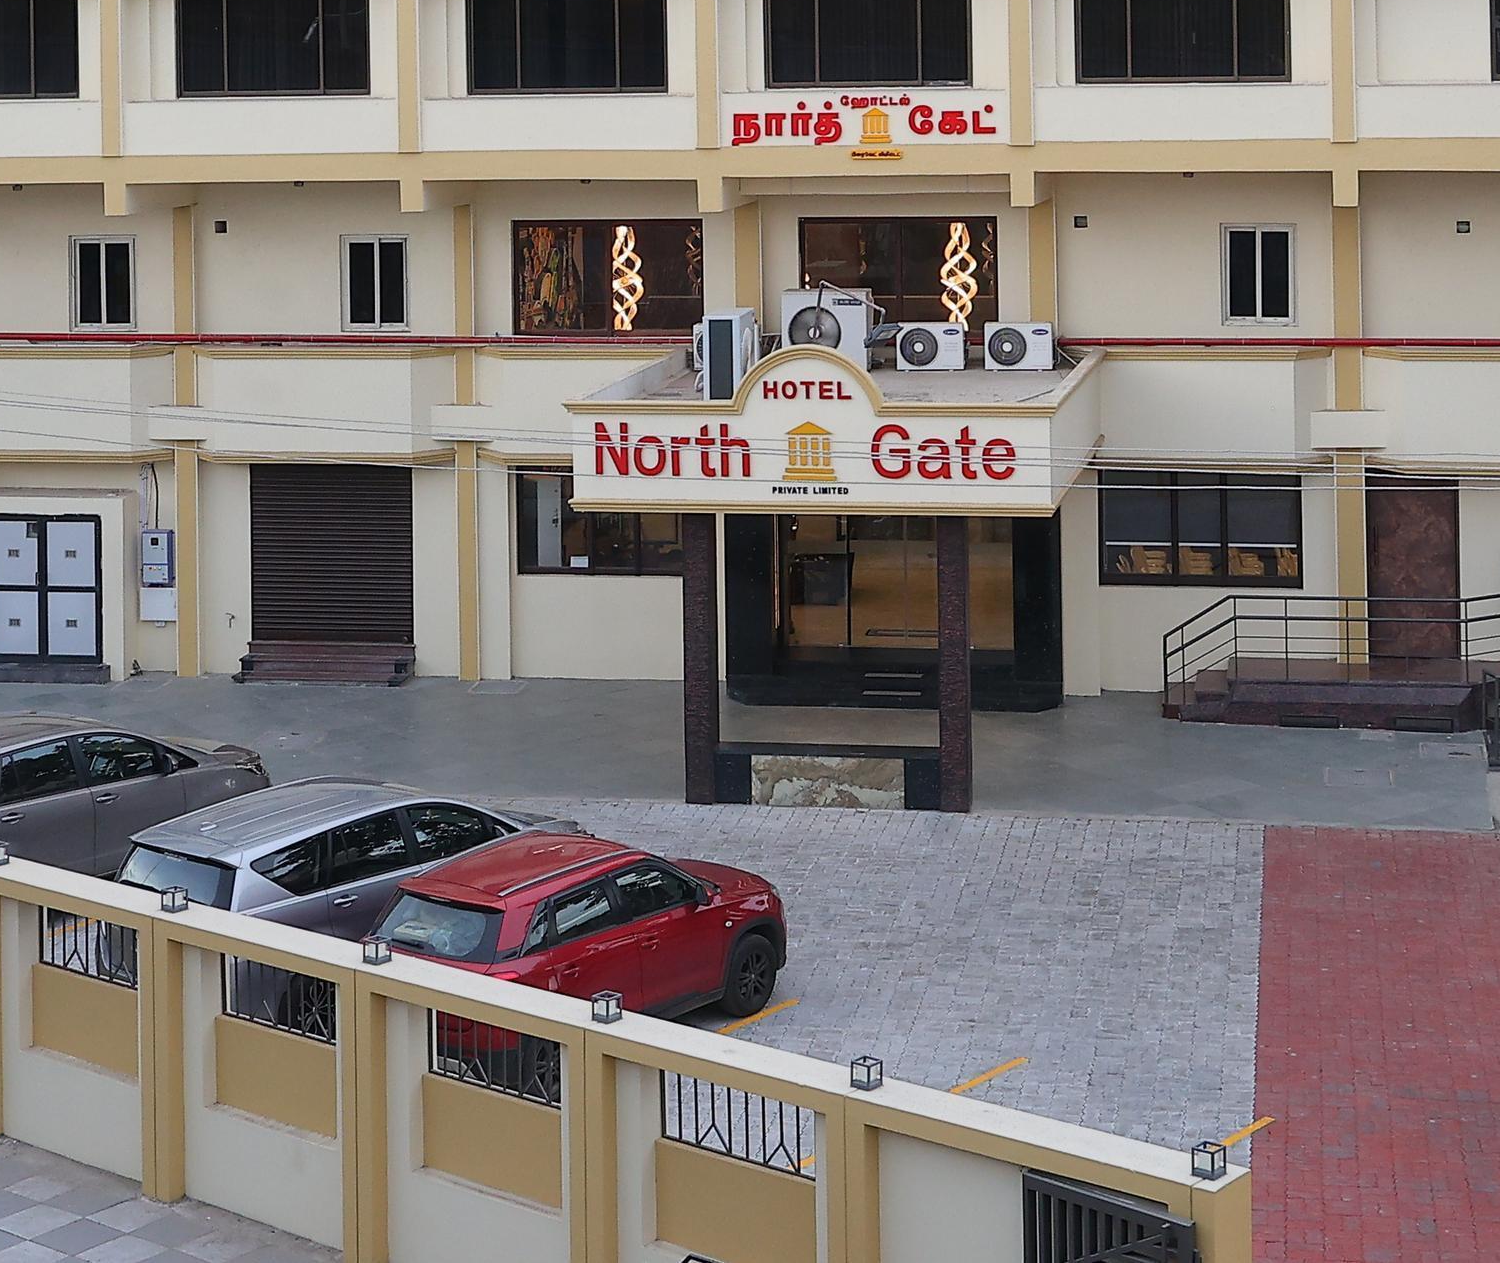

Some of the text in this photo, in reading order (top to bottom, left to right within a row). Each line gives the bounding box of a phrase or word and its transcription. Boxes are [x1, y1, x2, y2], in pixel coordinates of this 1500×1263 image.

[839, 94, 911, 109] ஹோட்டல்
[731, 101, 997, 146] நார்த் கேட்
[762, 380, 853, 401] HOTEL
[594, 422, 1017, 481] North Gate
[772, 486, 850, 495] PRIVATE LIMITED
